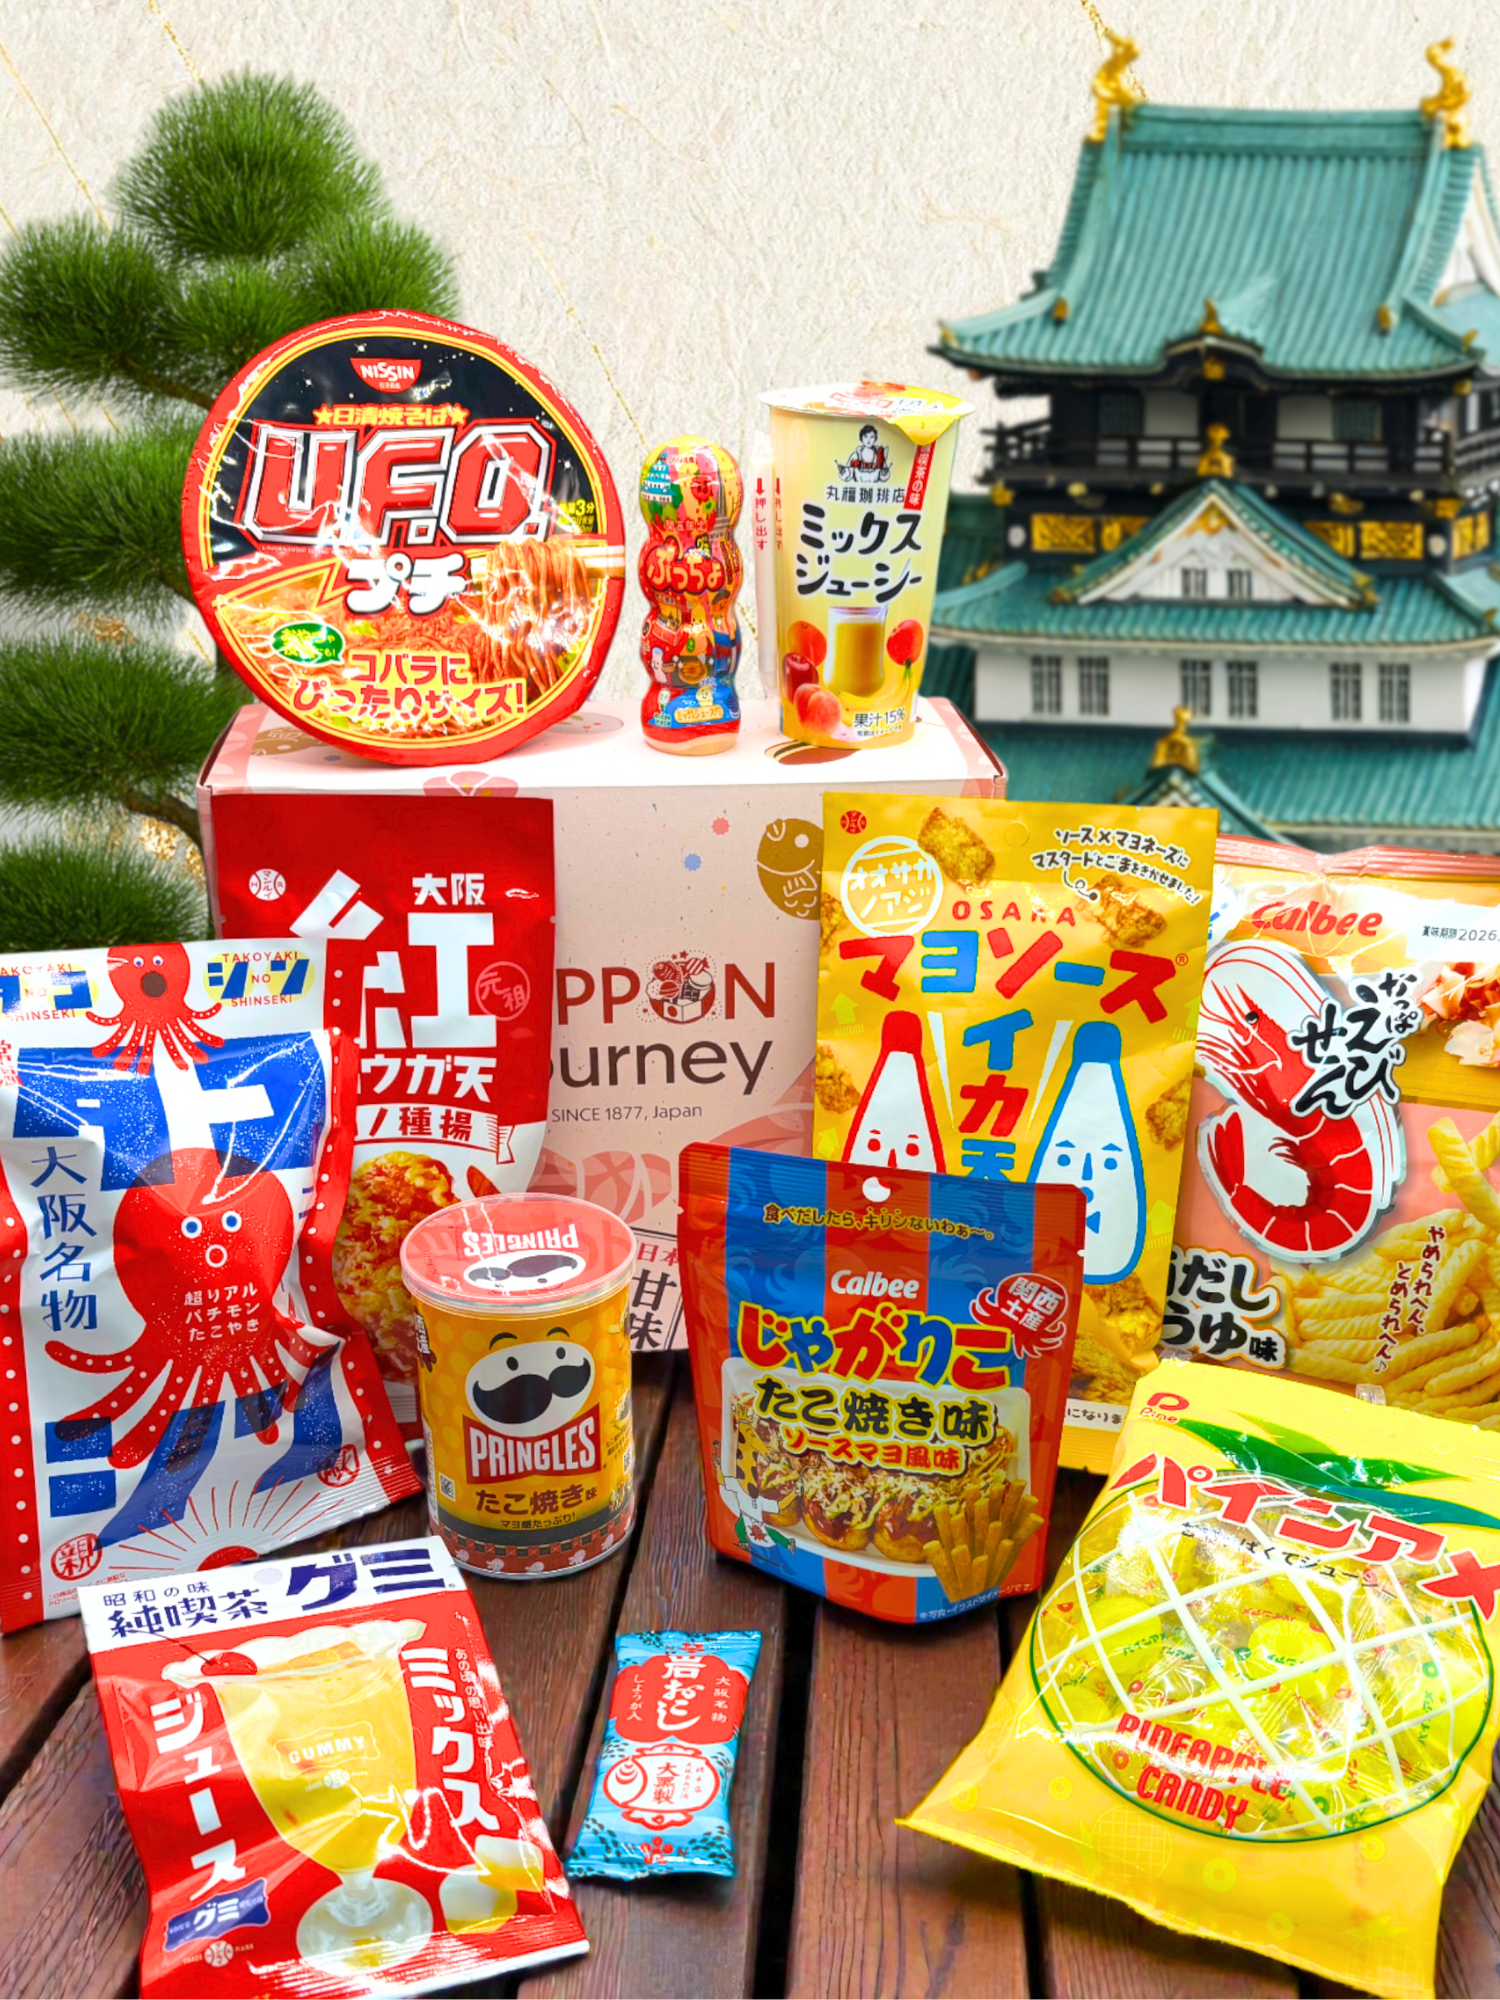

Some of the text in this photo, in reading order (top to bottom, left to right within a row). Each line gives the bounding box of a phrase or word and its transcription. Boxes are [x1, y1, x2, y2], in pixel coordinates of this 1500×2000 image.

[360, 362, 415, 381] NISSIN
[333, 407, 447, 426] 日清焼そば
[827, 485, 905, 502] 丸福珈琲店
[755, 498, 768, 550] 押し出す
[800, 503, 922, 555] ミックス
[346, 553, 466, 615] プチ
[644, 545, 722, 590] ぷっちょ
[796, 553, 922, 603] ジューシー
[350, 653, 468, 685] コバラに
[292, 679, 524, 719] ぴったりサイズ!
[412, 873, 486, 906] 大阪
[850, 858, 933, 890] オオサカ
[860, 887, 931, 918] ノアジ
[1251, 901, 1383, 936] Calbee
[222, 950, 299, 964] TAKOYAKI
[839, 927, 1176, 1024] マヨソース
[251, 974, 272, 985] NO
[480, 971, 527, 1012] 元祖
[231, 995, 293, 1008] SHINSEKI
[357, 1054, 497, 1102] ウガ天
[550, 1040, 773, 1095] urney
[552, 1105, 703, 1122] SINCE 1877, Japan
[30, 1146, 98, 1333] 大阪名物
[462, 1223, 580, 1258] PRINGLES
[830, 1269, 920, 1299] Calbee
[1008, 1276, 1064, 1313] 関西
[1167, 1253, 1271, 1313] だし
[185, 1302, 260, 1324] パチモン
[189, 1318, 259, 1342] たこやき
[1000, 1297, 1044, 1332] 土産
[739, 1303, 1012, 1391] じゃがりこ
[753, 1377, 994, 1442] たこ焼き味
[1139, 1406, 1179, 1425] Pine
[470, 1416, 596, 1477] PRINGLES
[785, 1427, 963, 1470] ソースマヨ風味
[475, 1484, 598, 1516] たこ焼き味
[501, 1512, 576, 1529] マヨ感たっぷり!
[1108, 1451, 1500, 1622] パインアメ
[103, 1582, 211, 1607] 昭和の味
[108, 1549, 446, 1640] 純喫茶 グミ
[626, 1673, 646, 1721] しょうが入
[656, 1655, 707, 1731] 岩おこし
[711, 1675, 731, 1724] 大阪名物
[288, 1735, 366, 1764] GUMMY
[402, 1647, 500, 1830] ミックス
[151, 1691, 247, 1902] ジュース
[1136, 1765, 1250, 1830] CANDY
[193, 1897, 240, 1932] グミ
